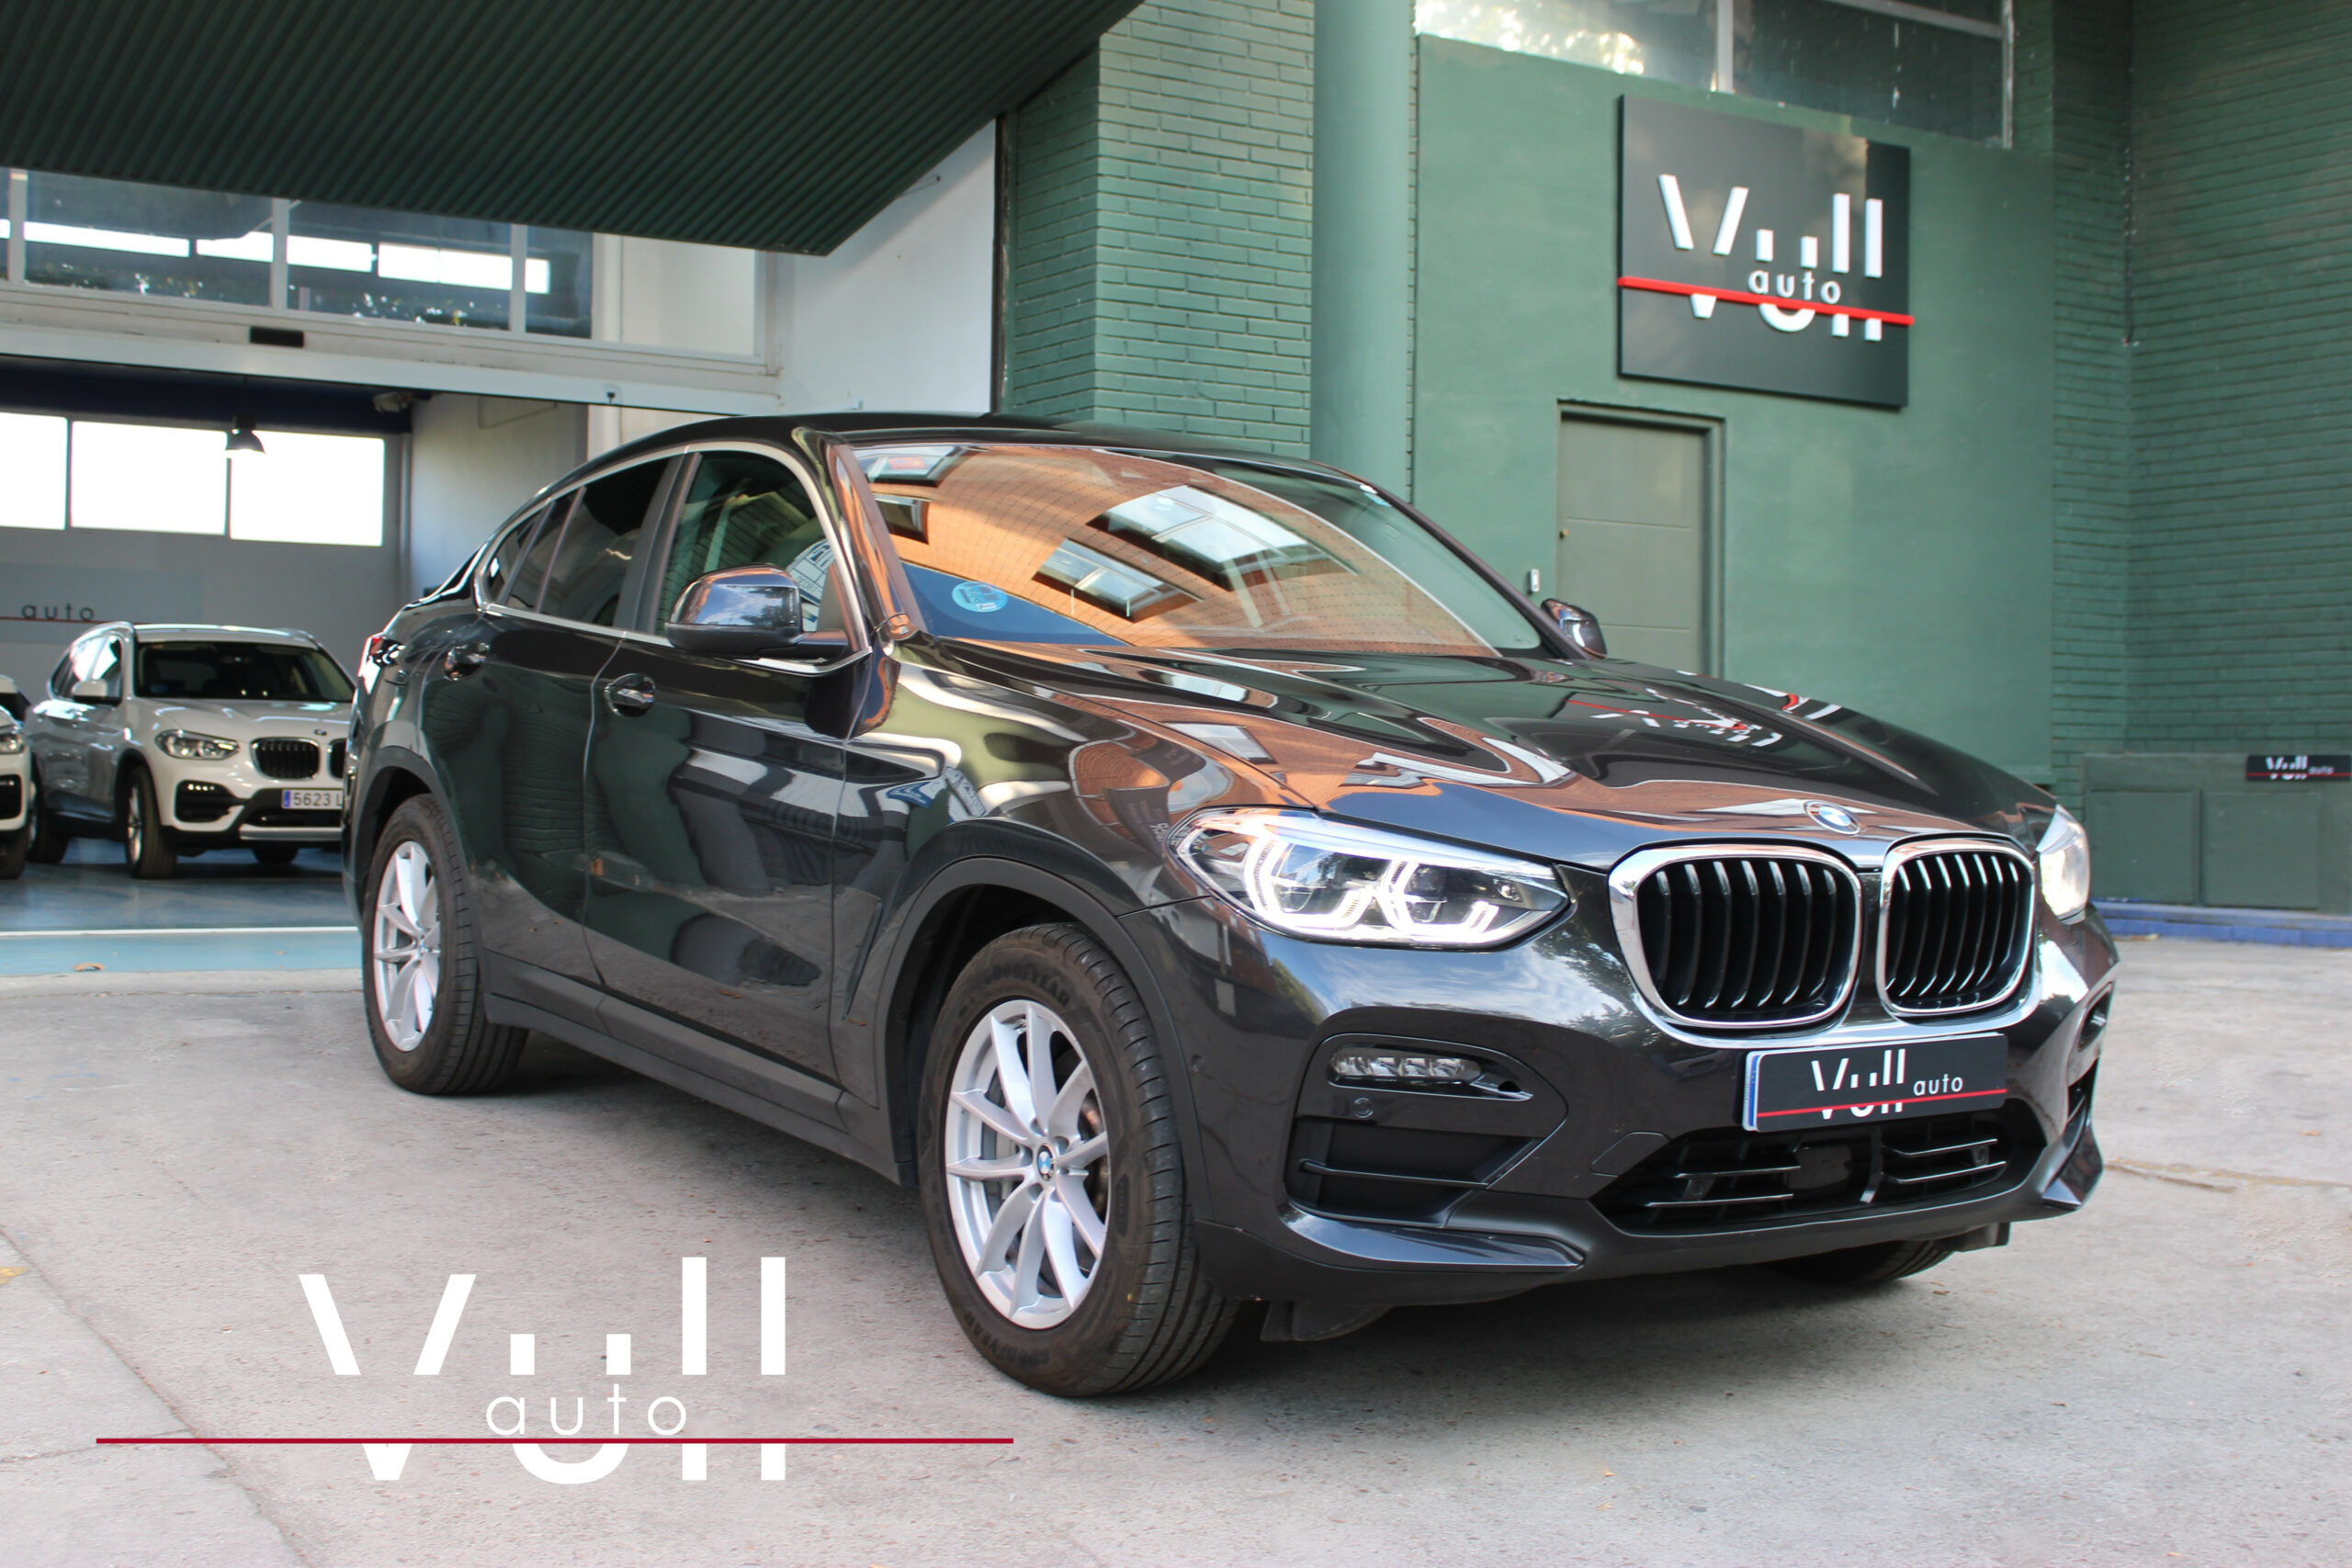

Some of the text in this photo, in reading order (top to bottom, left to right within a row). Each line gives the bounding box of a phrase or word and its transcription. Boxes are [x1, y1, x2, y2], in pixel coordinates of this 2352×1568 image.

[1747, 269, 1841, 305] auto
[22, 603, 96, 621] auto
[293, 792, 331, 807] 5623
[1913, 1073, 1964, 1096] auto
